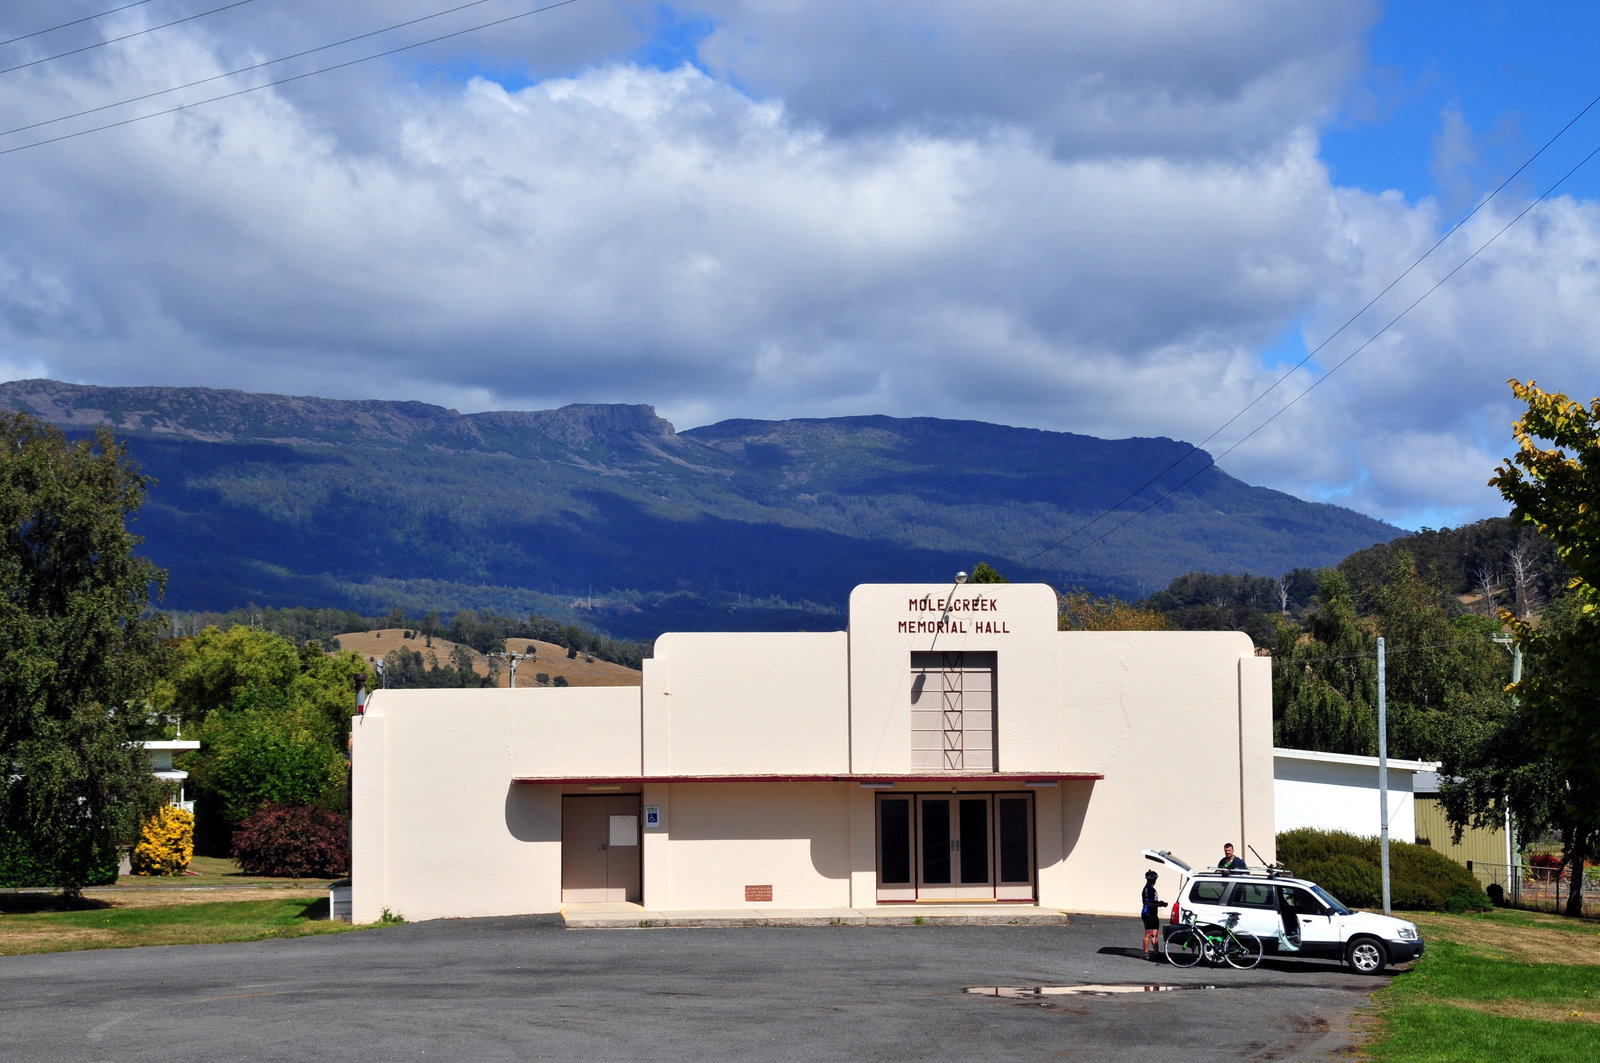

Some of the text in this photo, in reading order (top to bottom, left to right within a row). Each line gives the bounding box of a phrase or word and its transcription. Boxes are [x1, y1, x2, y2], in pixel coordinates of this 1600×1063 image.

[909, 598, 997, 611] MOLE CREEK
[898, 621, 1010, 633] MEMORIAL HALL
